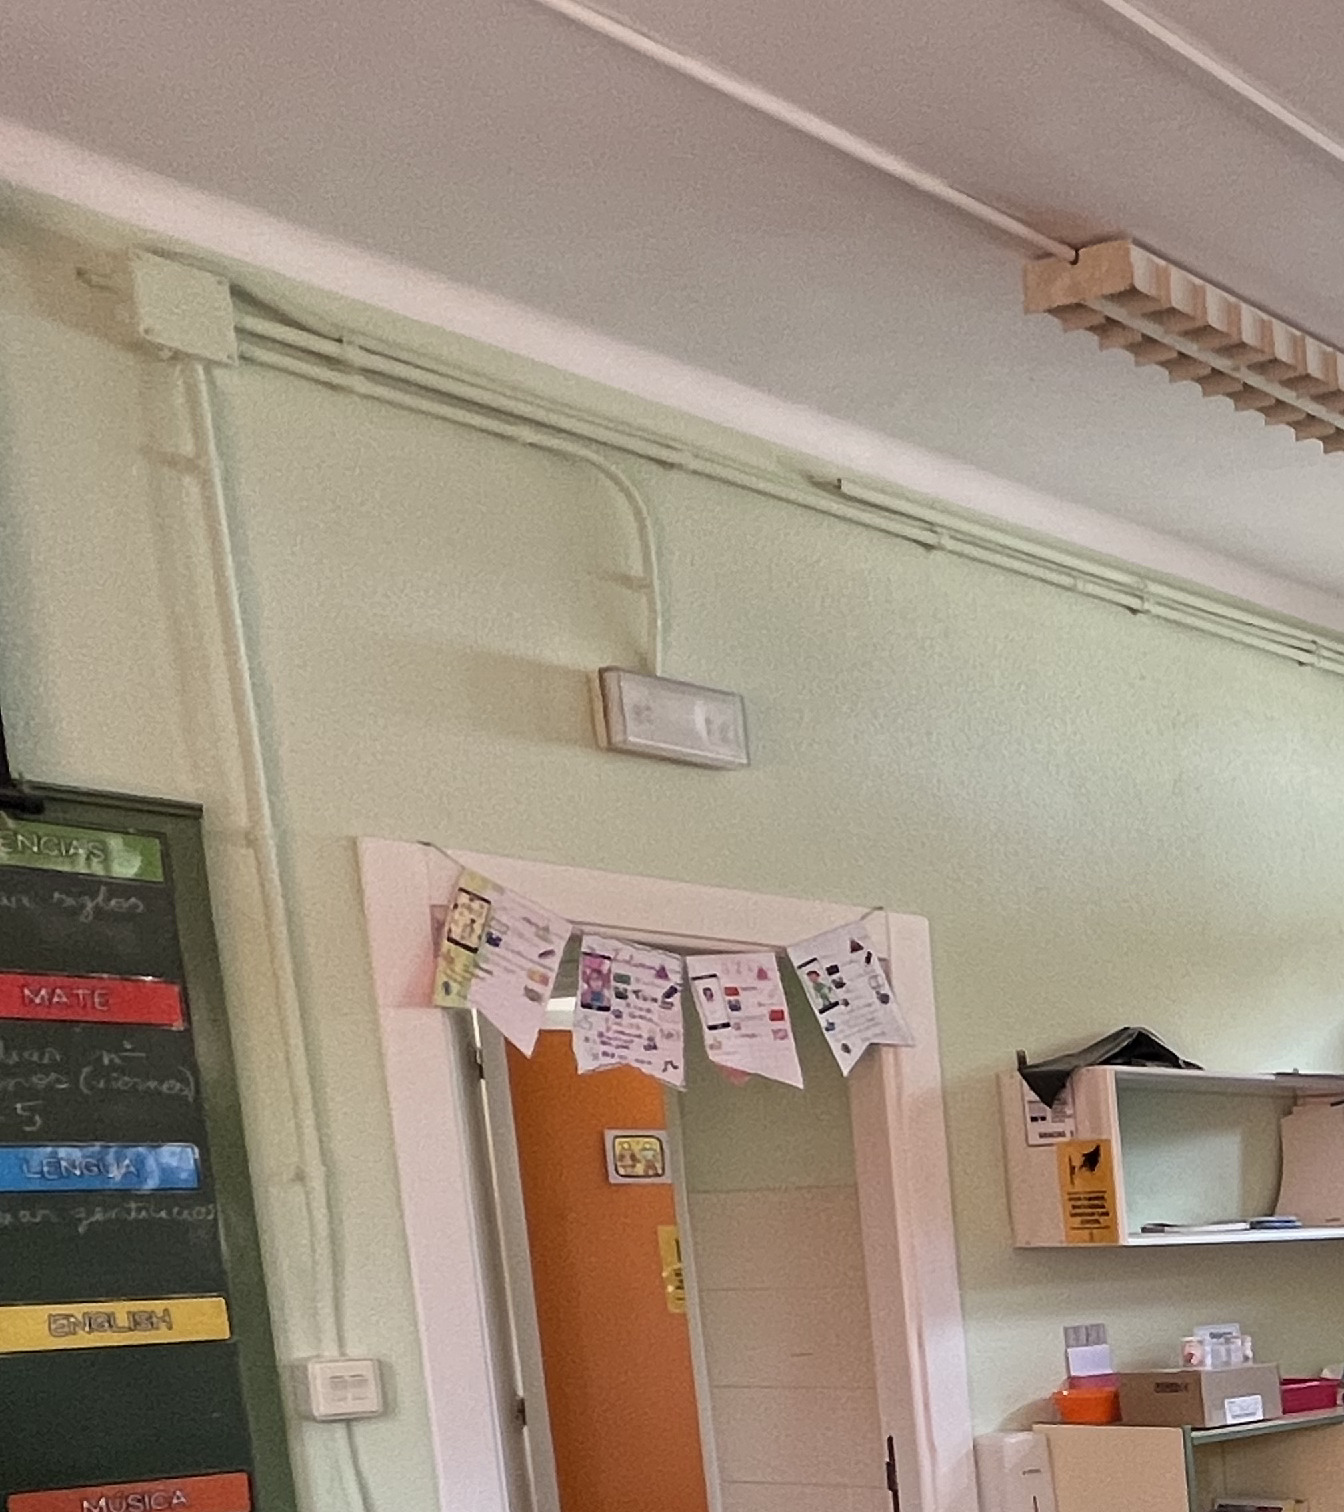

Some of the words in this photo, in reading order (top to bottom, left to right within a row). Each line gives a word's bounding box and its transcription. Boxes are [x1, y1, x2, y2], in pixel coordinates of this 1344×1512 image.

[23, 986, 110, 1011] MATE
[22, 1157, 138, 1183] LENGUA
[47, 1308, 173, 1338] ENGLISH
